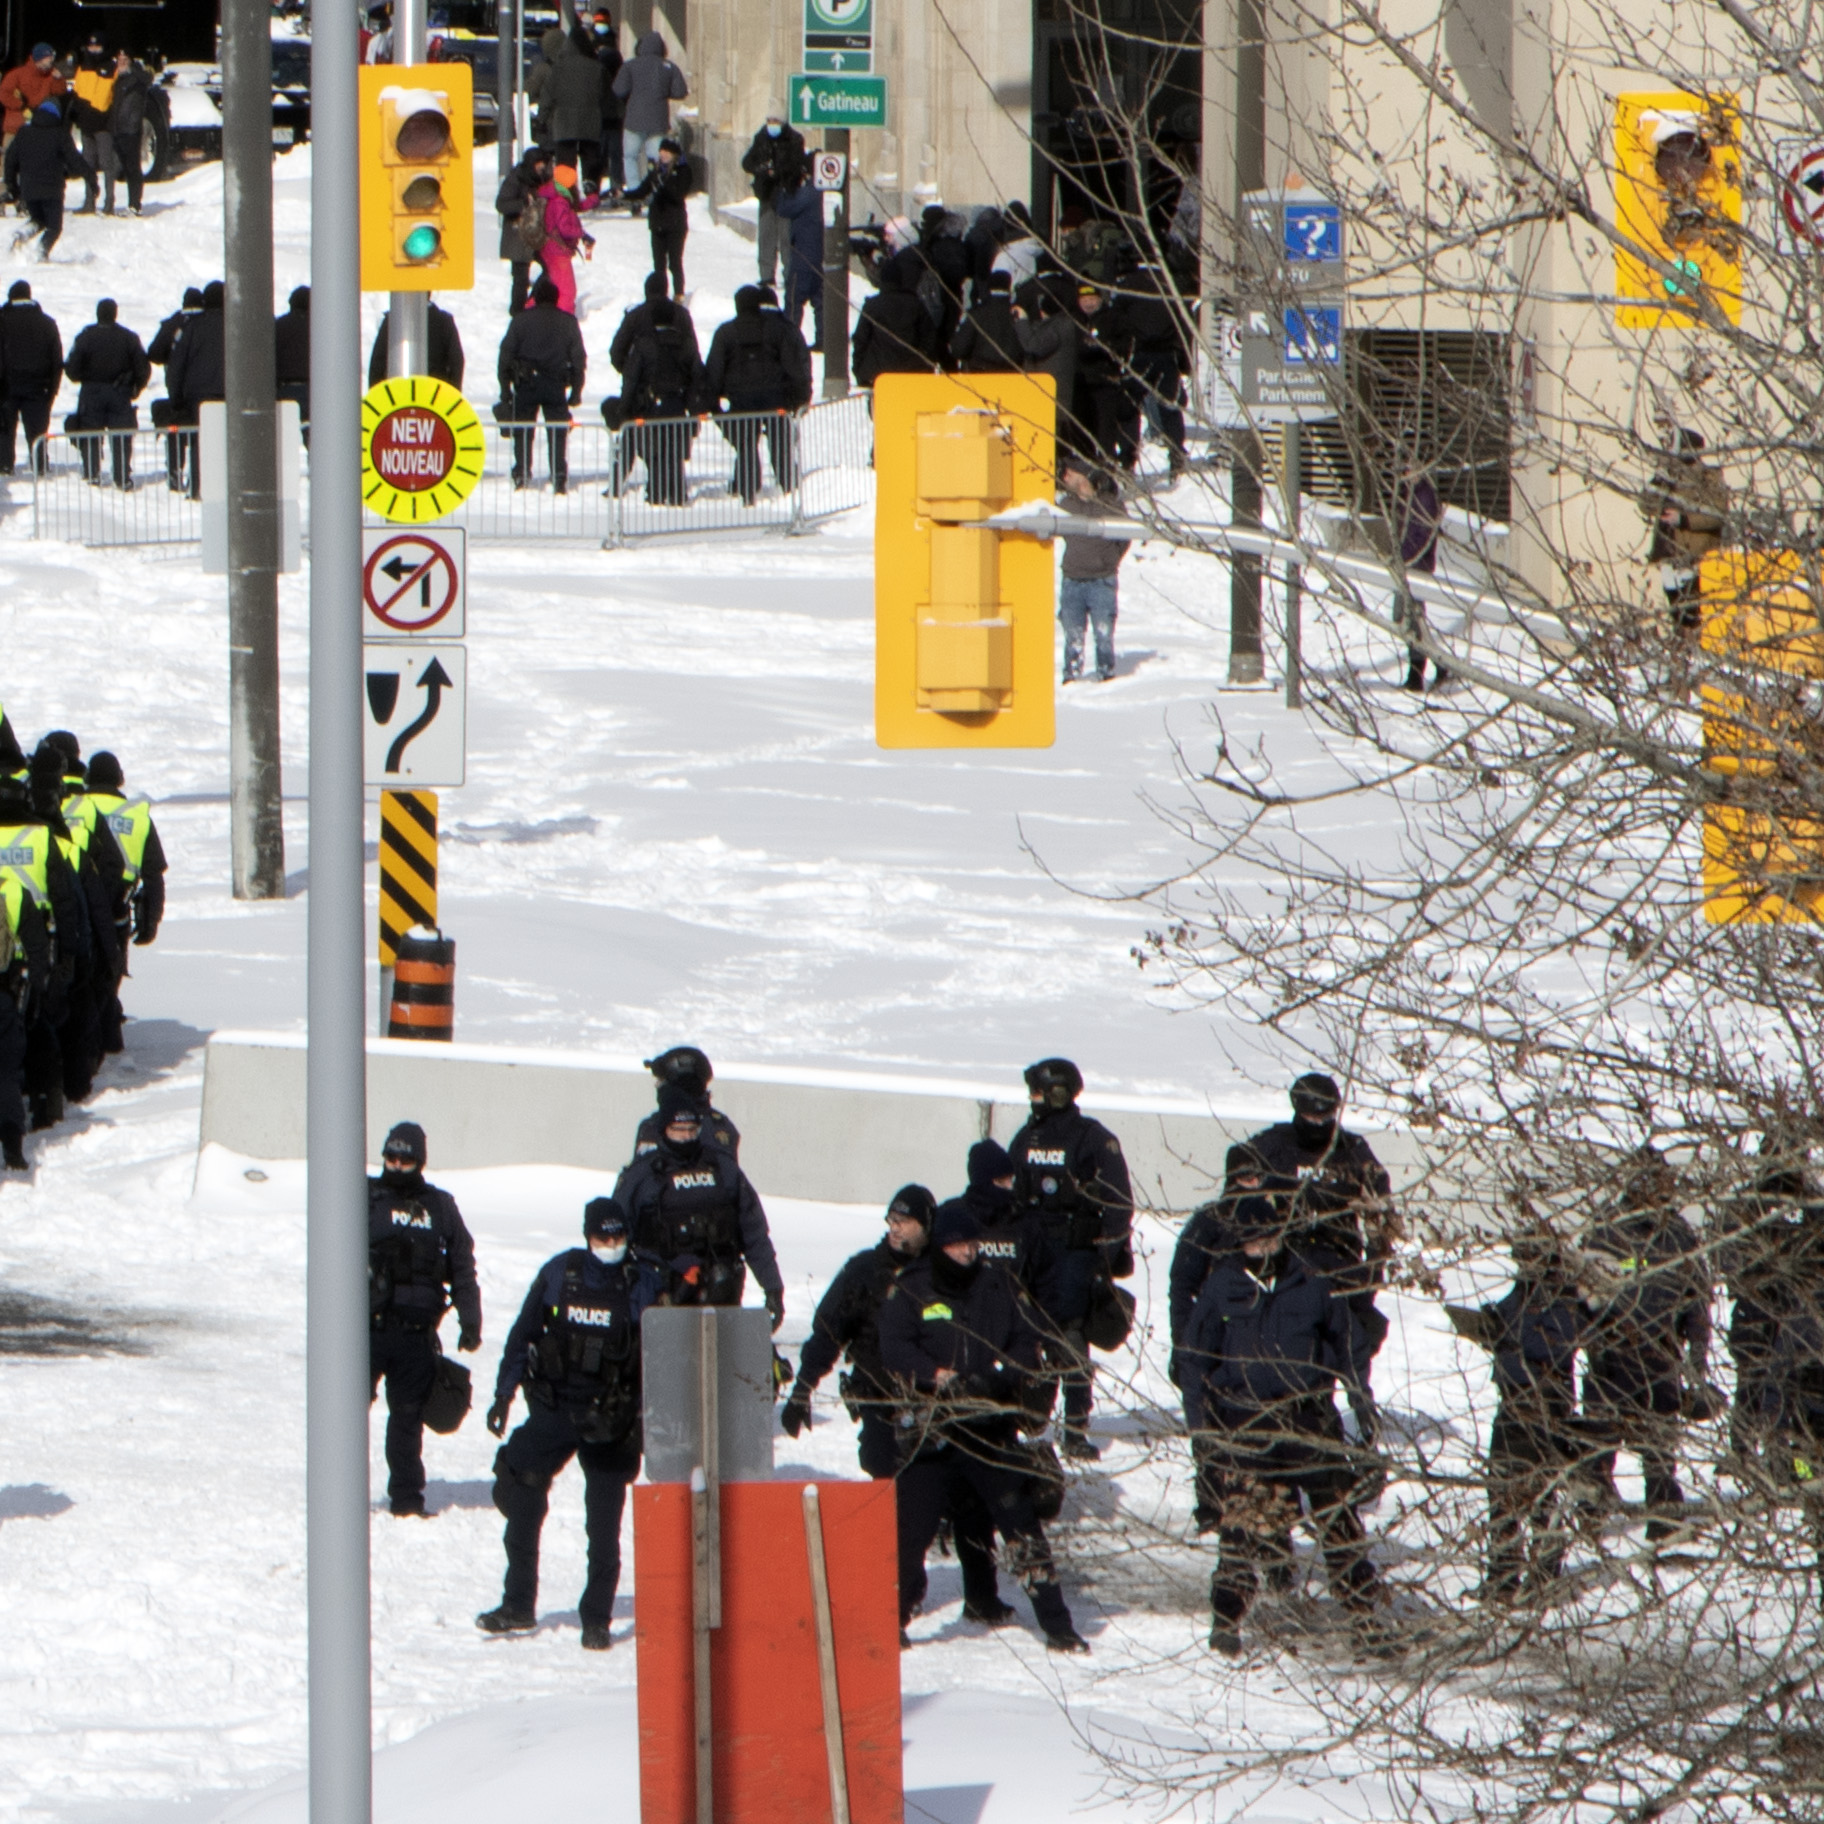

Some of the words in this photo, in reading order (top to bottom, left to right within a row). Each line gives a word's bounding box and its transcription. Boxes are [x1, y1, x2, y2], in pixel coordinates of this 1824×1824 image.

[817, 90, 879, 113] Gatineau
[392, 417, 436, 445] NEW
[381, 448, 445, 476] NOUVEAU
[1027, 1148, 1066, 1166] POLICE
[673, 1172, 716, 1190] POLICE
[566, 1306, 612, 1326] POLICE
